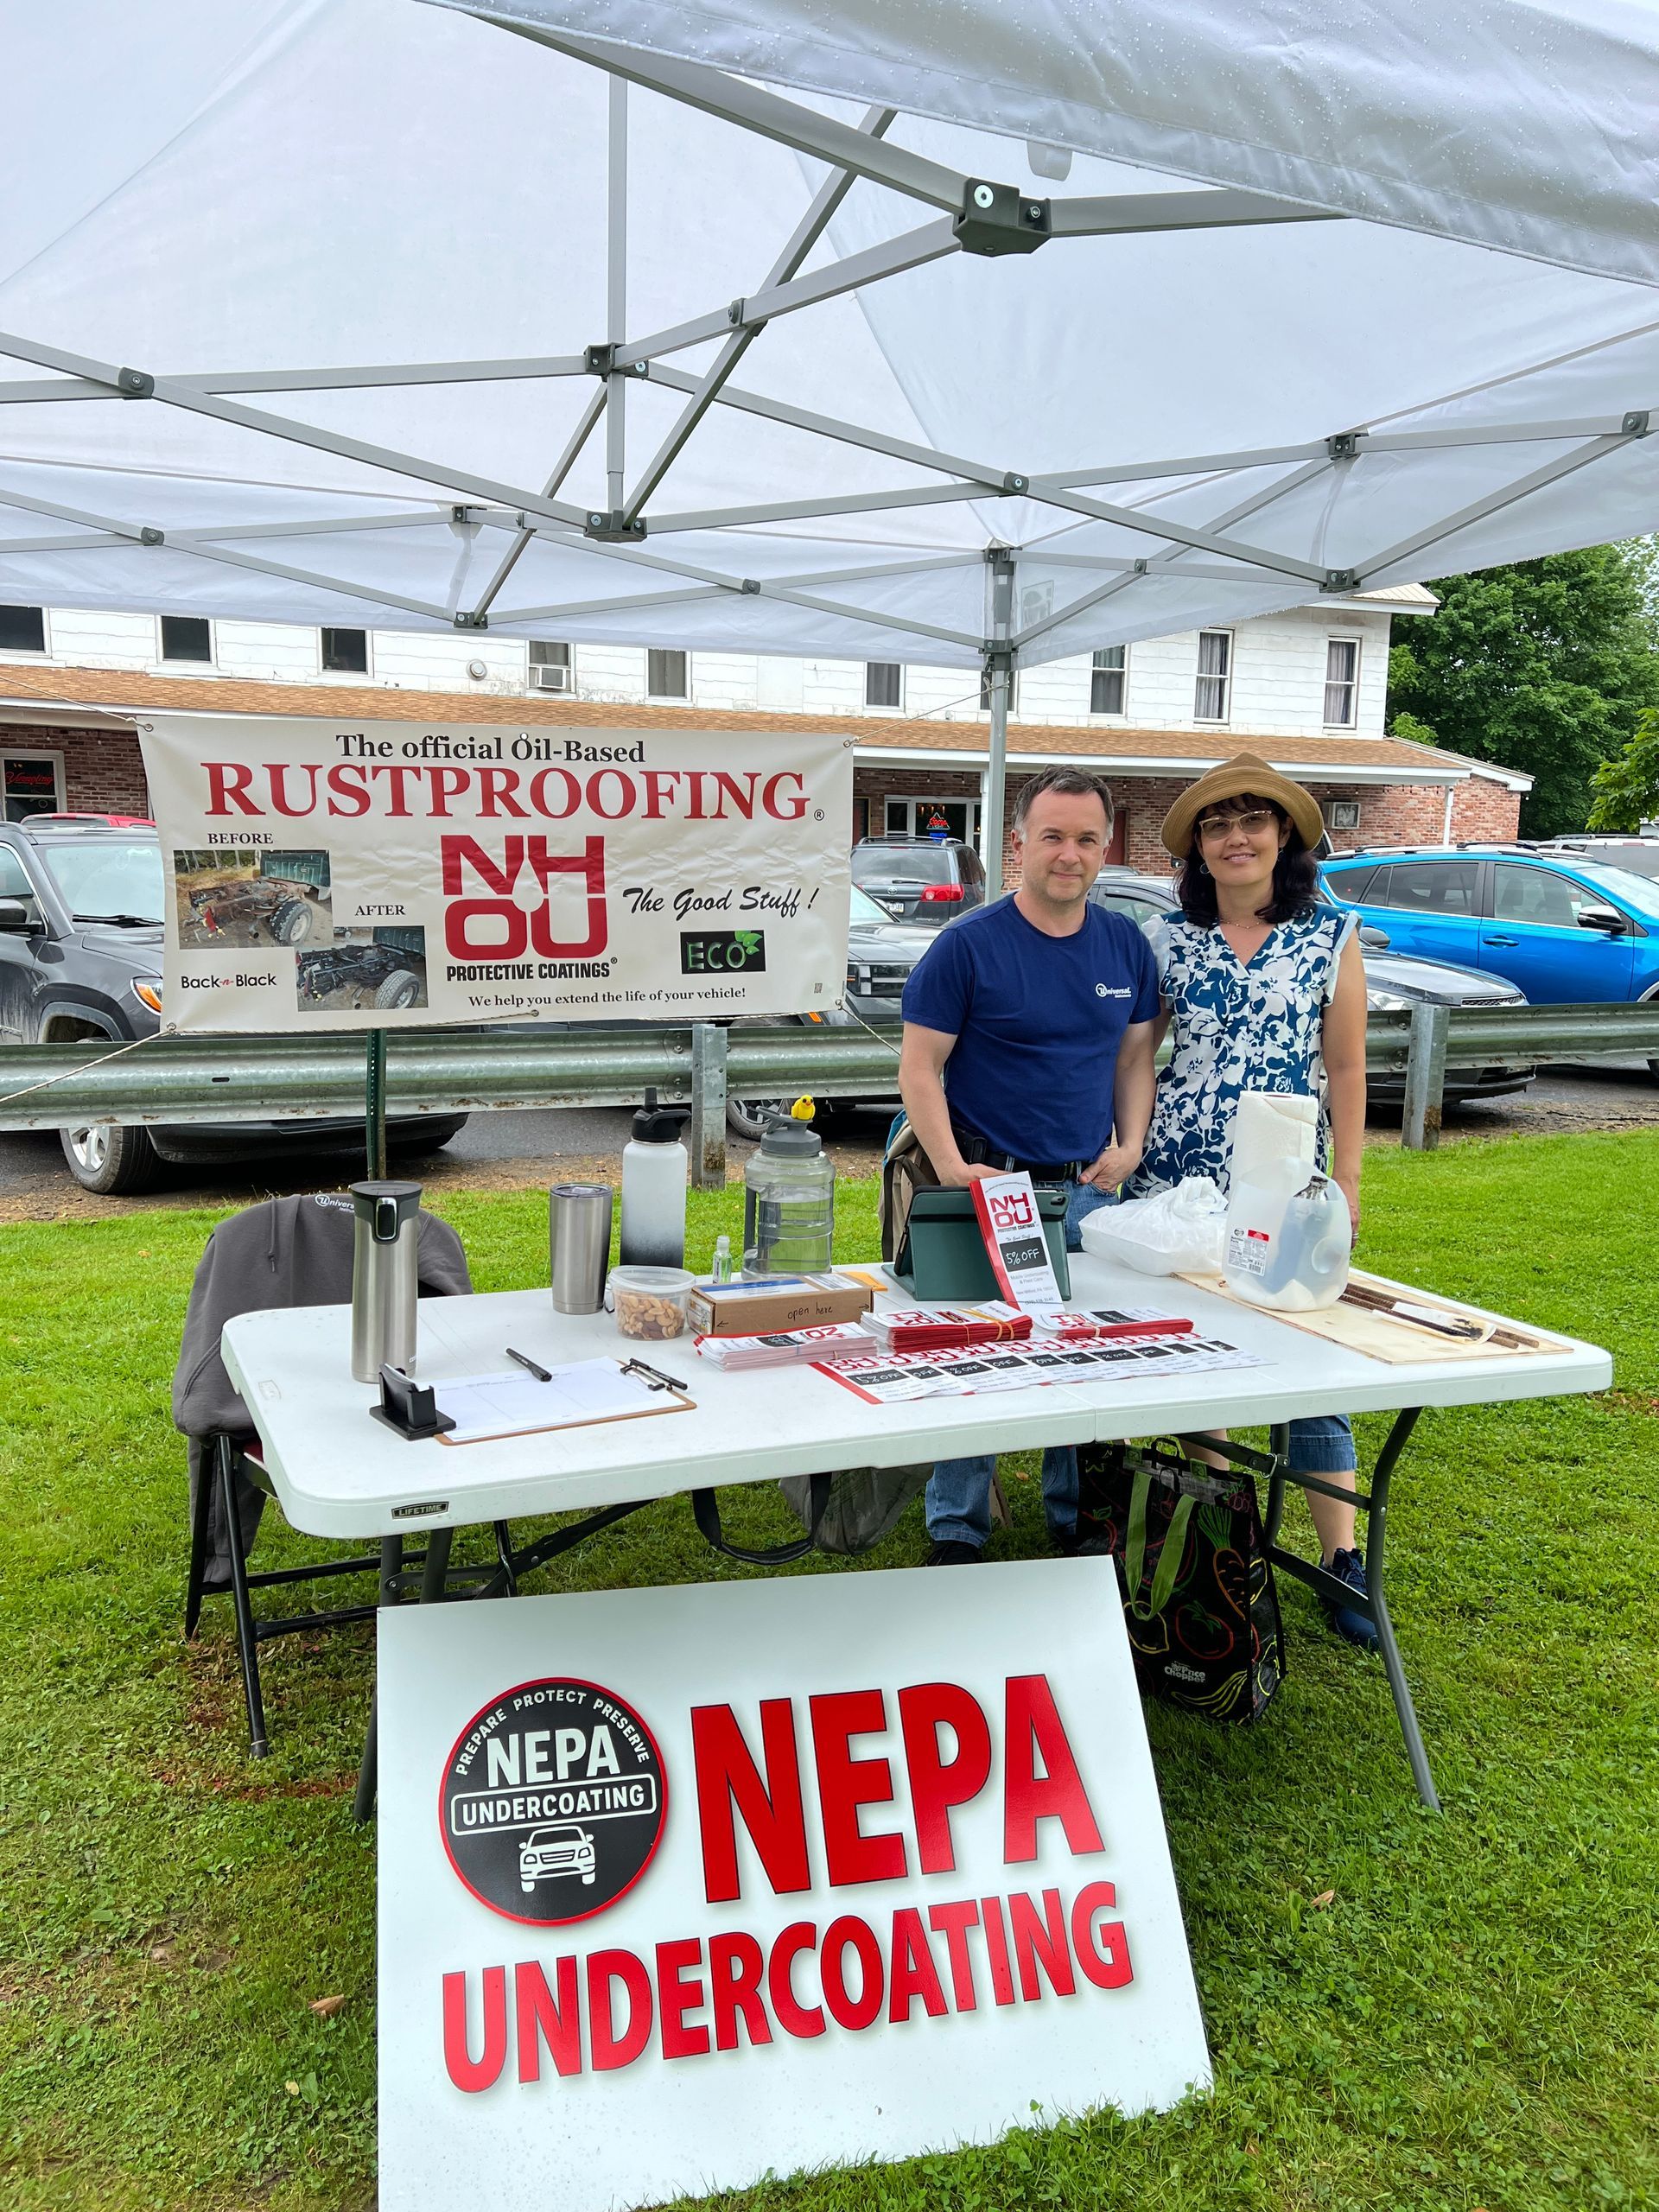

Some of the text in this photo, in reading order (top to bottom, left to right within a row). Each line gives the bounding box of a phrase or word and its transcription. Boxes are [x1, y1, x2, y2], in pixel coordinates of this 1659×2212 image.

[336, 734, 645, 762] The official Oil-Based
[200, 762, 810, 820] RUSTPROOFING
[207, 832, 273, 845] BEFORE
[354, 905, 405, 917] AFTER
[623, 887, 664, 914] The
[674, 888, 732, 921] Good
[739, 887, 802, 918] Stuff
[687, 941, 747, 969] ECO
[447, 963, 610, 982] PROTECTIVE COATINGS
[468, 988, 746, 1007] We help you extend the life of your vehicle!
[315, 1194, 354, 1209] Univers
[1021, 1249, 1039, 1261] OFF
[787, 1302, 833, 1322] open here
[398, 1504, 442, 1516] LIFETIME
[1164, 1666, 1205, 1683] Chopper
[455, 1689, 650, 1776] PREPARE PROTECT PRESERVE
[486, 1725, 621, 1788] NEPA
[690, 1674, 1106, 1904] NEPA
[462, 1784, 645, 1826] UNDERCOATING
[442, 1880, 1135, 2094] UNDERCOATING
